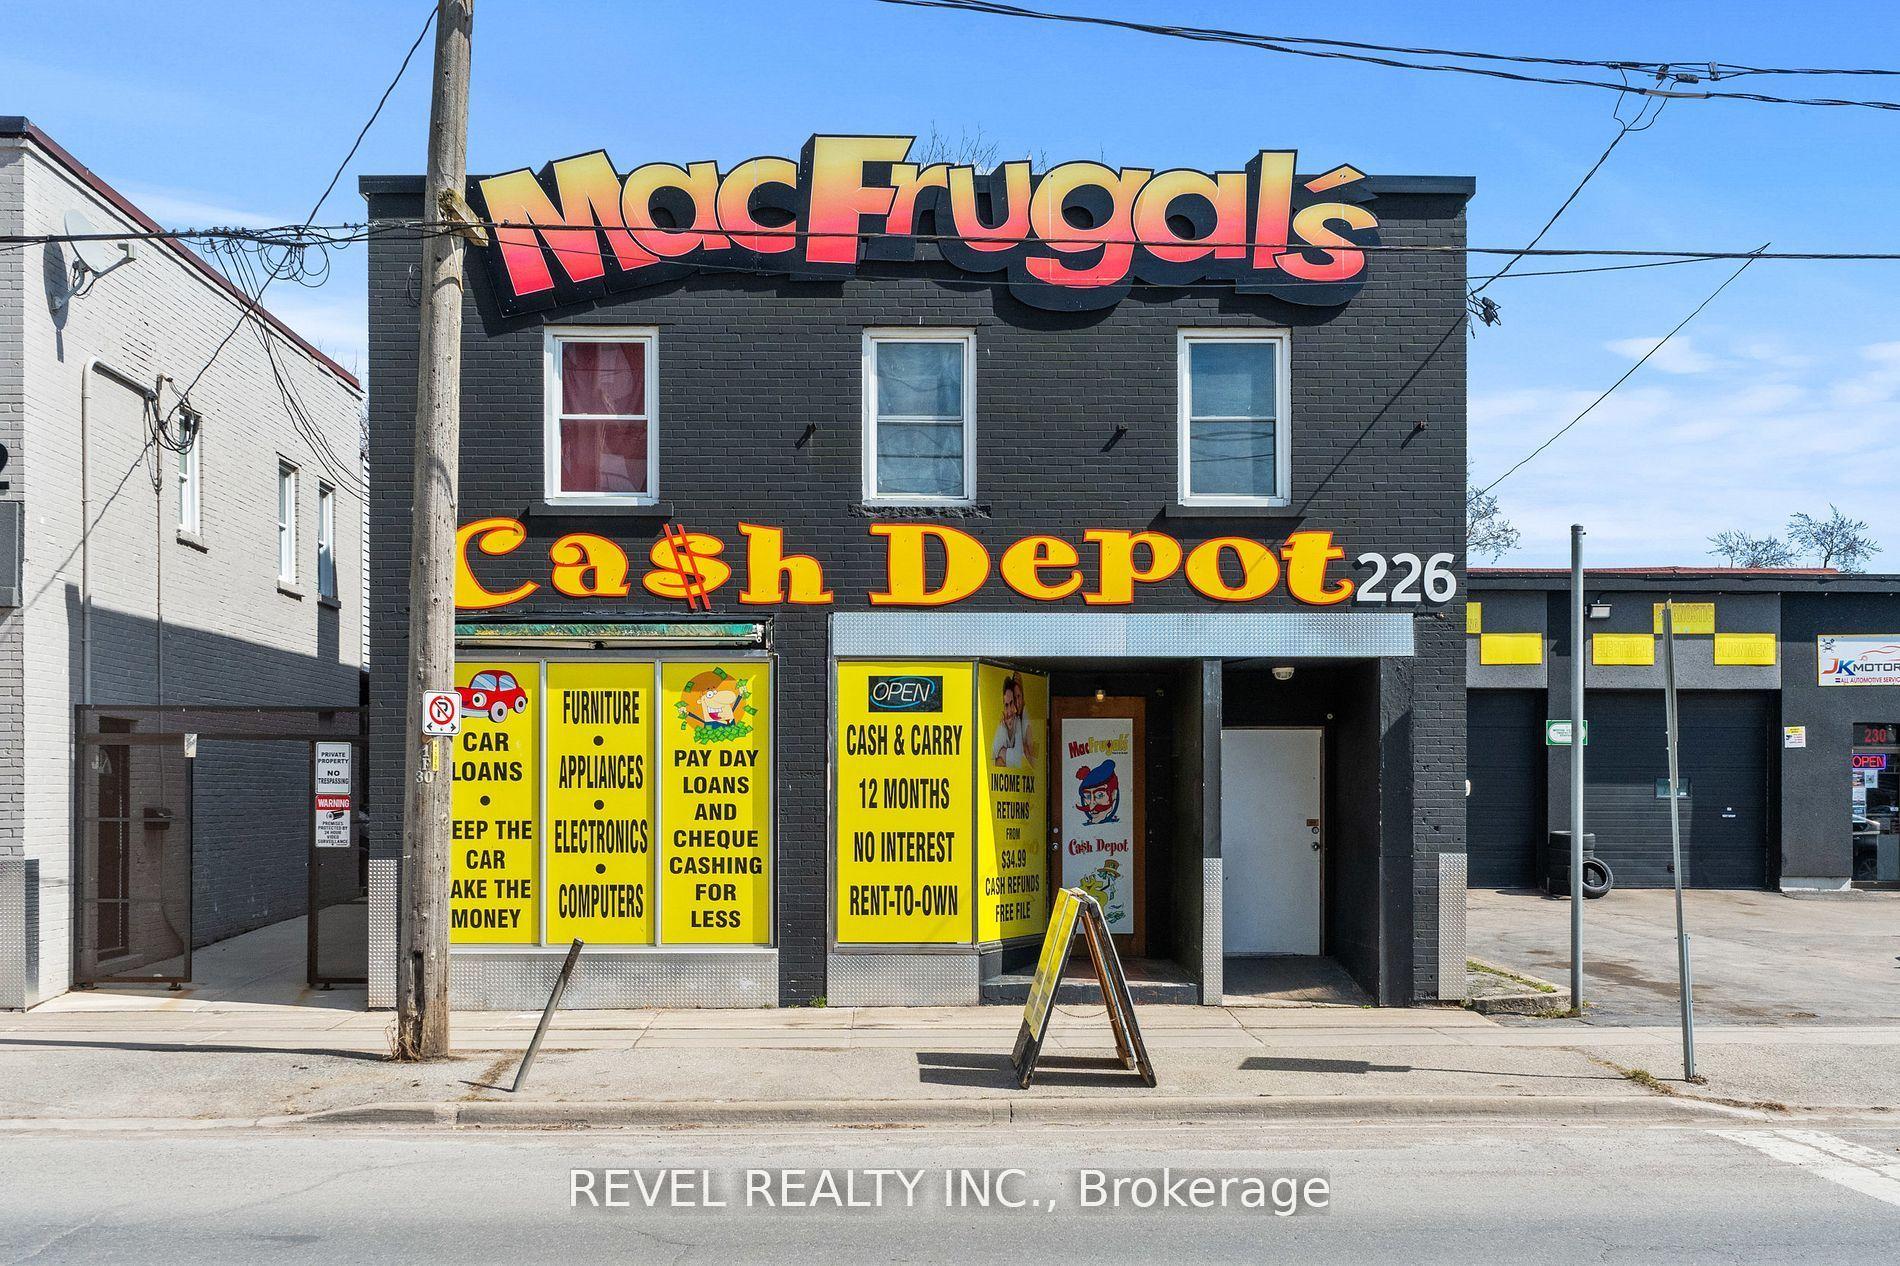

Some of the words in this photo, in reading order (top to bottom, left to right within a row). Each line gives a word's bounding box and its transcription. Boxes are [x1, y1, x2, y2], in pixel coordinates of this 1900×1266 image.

[869, 523, 1356, 607] Depot
[1357, 552, 1458, 604] 226
[1821, 657, 1856, 677] JK
[873, 682, 930, 702] OPEN
[563, 690, 641, 725] FURNITURE
[463, 732, 510, 752] CAR
[847, 725, 888, 757] CASH
[894, 725, 905, 757] &
[911, 725, 963, 757] CARRY
[1864, 728, 1887, 743] 230
[675, 750, 711, 768] PAY
[720, 750, 760, 768] DAY
[1852, 755, 1884, 768] OPEN
[318, 777, 349, 785] TRESPASSING
[452, 762, 524, 783] LOANS
[559, 755, 645, 791] APPLIANCES
[683, 776, 750, 795] LOANS
[859, 778, 878, 810] 12
[884, 778, 950, 810] MONTHS
[991, 773, 1020, 793] INCOME
[1022, 775, 1035, 794] TAX
[318, 798, 350, 808] WARNING
[694, 803, 738, 822] AND
[996, 801, 1030, 820] RETURNS
[452, 820, 489, 841] EEP
[495, 820, 533, 841] THE
[555, 819, 649, 855] ELECTRONICS
[673, 830, 760, 851] CHEQUE
[1006, 827, 1021, 841] FROM
[854, 831, 876, 864] NO
[881, 831, 956, 864] INTEREST
[1096, 838, 1130, 857] Depot
[466, 849, 506, 870] CAR
[669, 856, 763, 876] CASHING
[1001, 849, 1027, 871] $34.99
[451, 880, 488, 900] AKE
[494, 880, 532, 900] THE
[695, 883, 737, 903] FOR
[985, 876, 1006, 897] CASH
[1007, 874, 1040, 895] REFUNDS
[558, 884, 645, 920] COMPUTERS
[850, 885, 959, 918] RENT-TO-OWN
[451, 909, 522, 930] MONEY
[691, 910, 742, 930] LESS
[995, 904, 1014, 923] FREE
[1015, 902, 1031, 921] FILE
